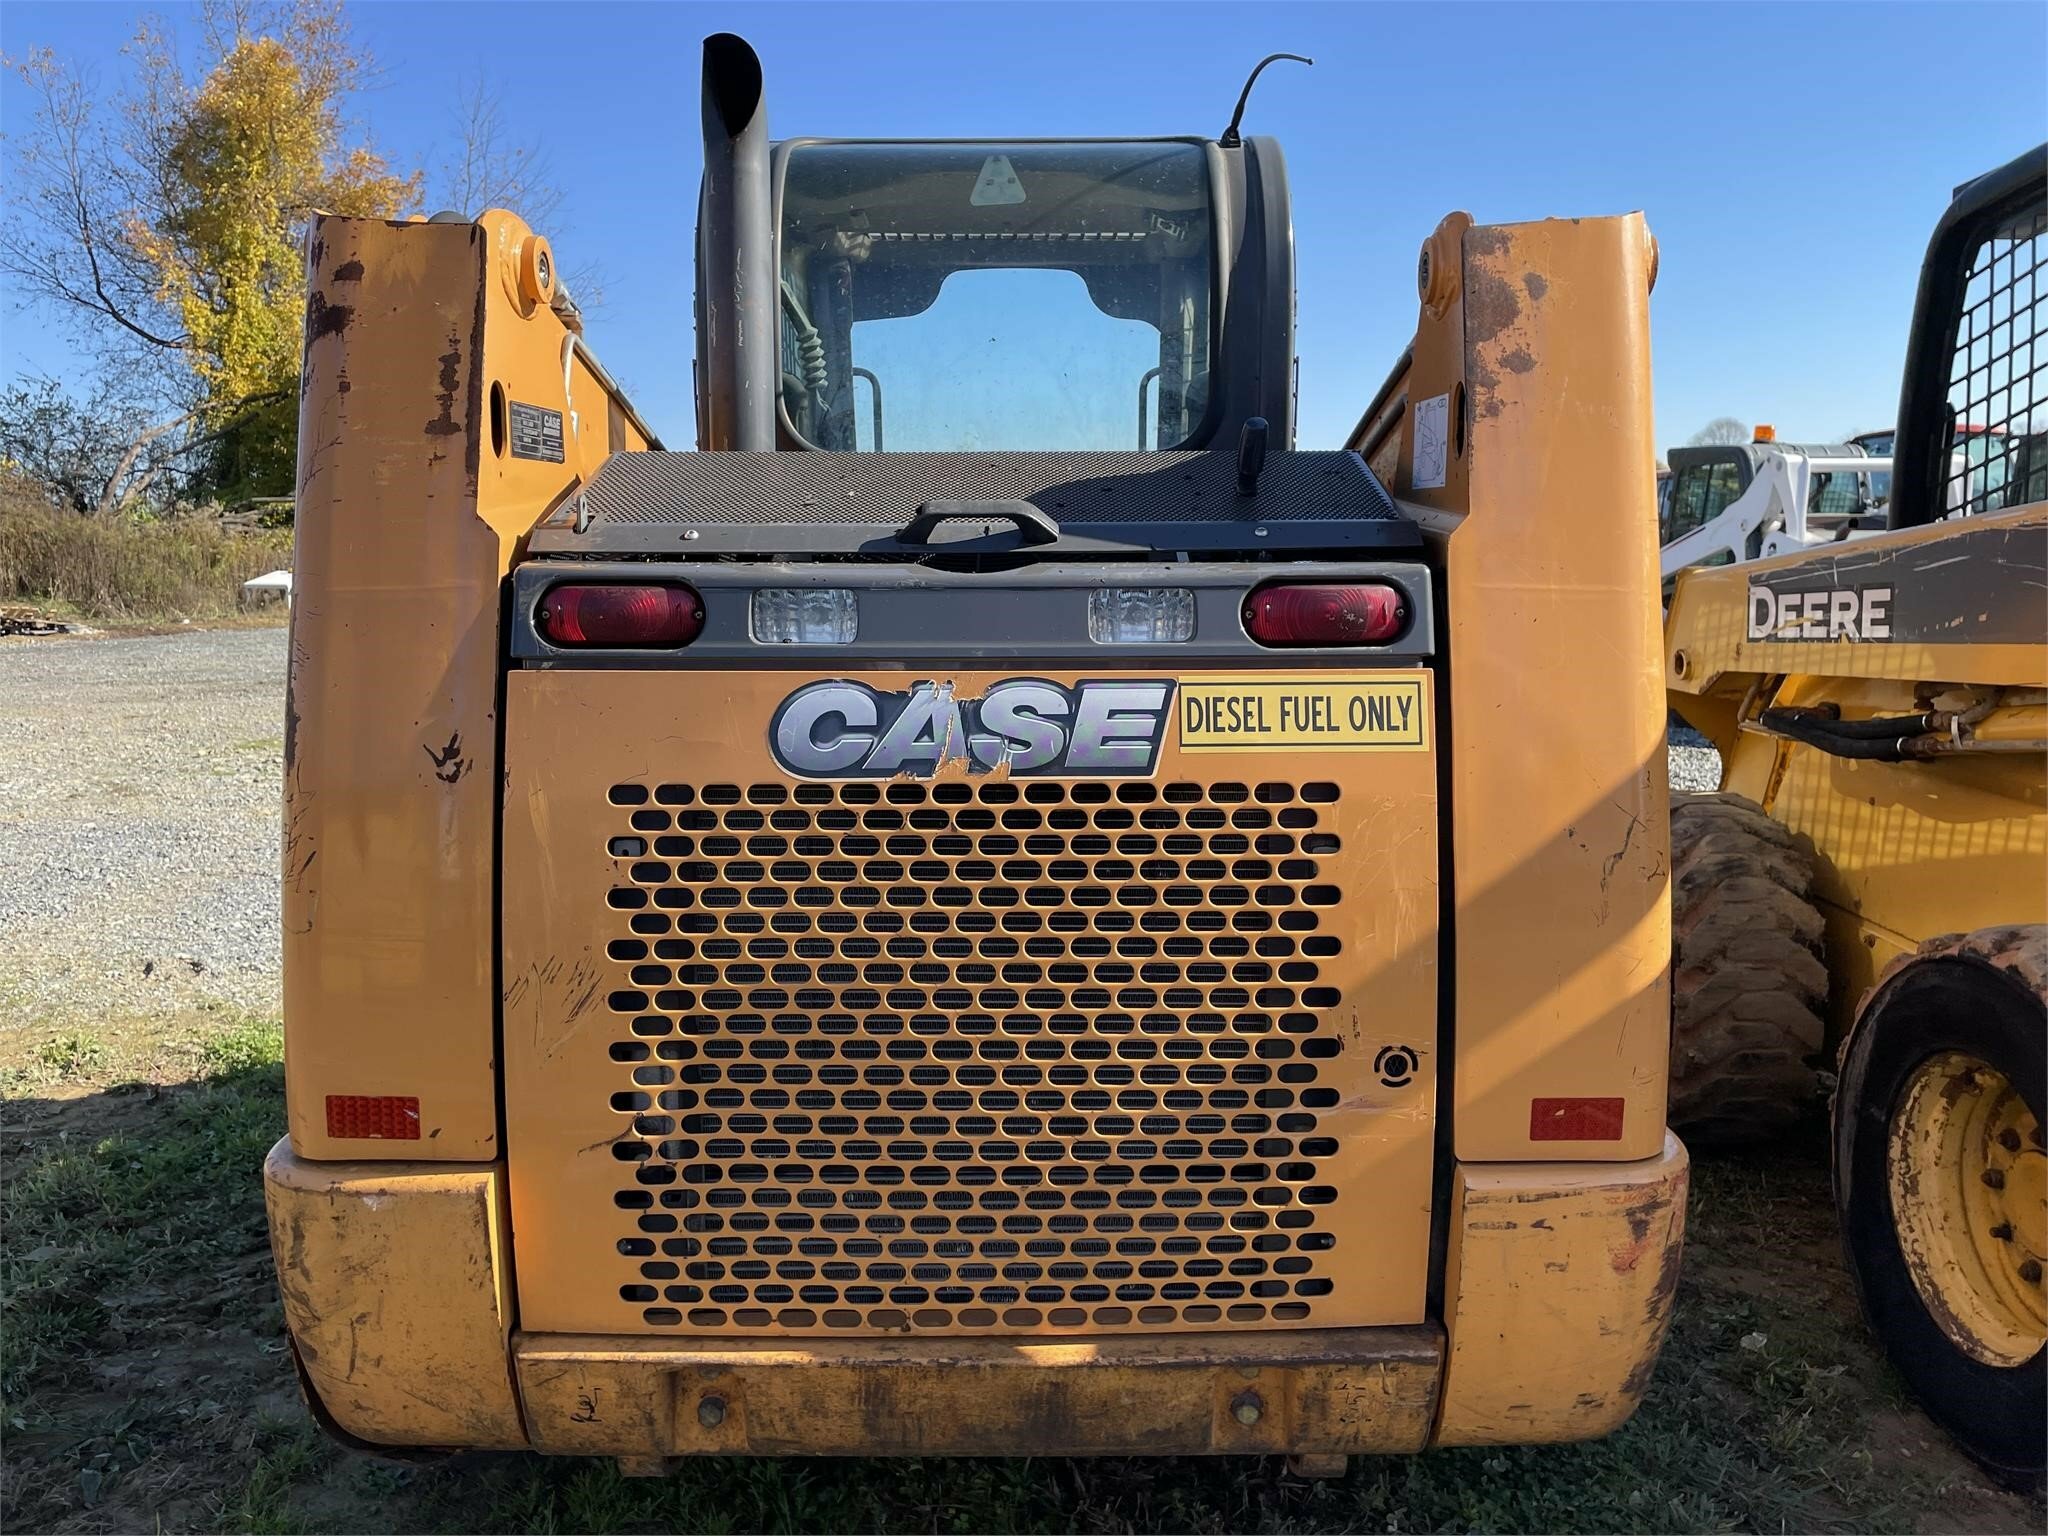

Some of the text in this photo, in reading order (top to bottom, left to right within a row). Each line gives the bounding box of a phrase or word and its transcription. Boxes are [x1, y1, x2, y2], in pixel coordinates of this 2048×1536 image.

[543, 415, 561, 429] CASE
[1749, 587, 1891, 639] DEERE
[773, 679, 1170, 773] CASE
[1186, 695, 1413, 733] DIESEL FUEL ONLY
